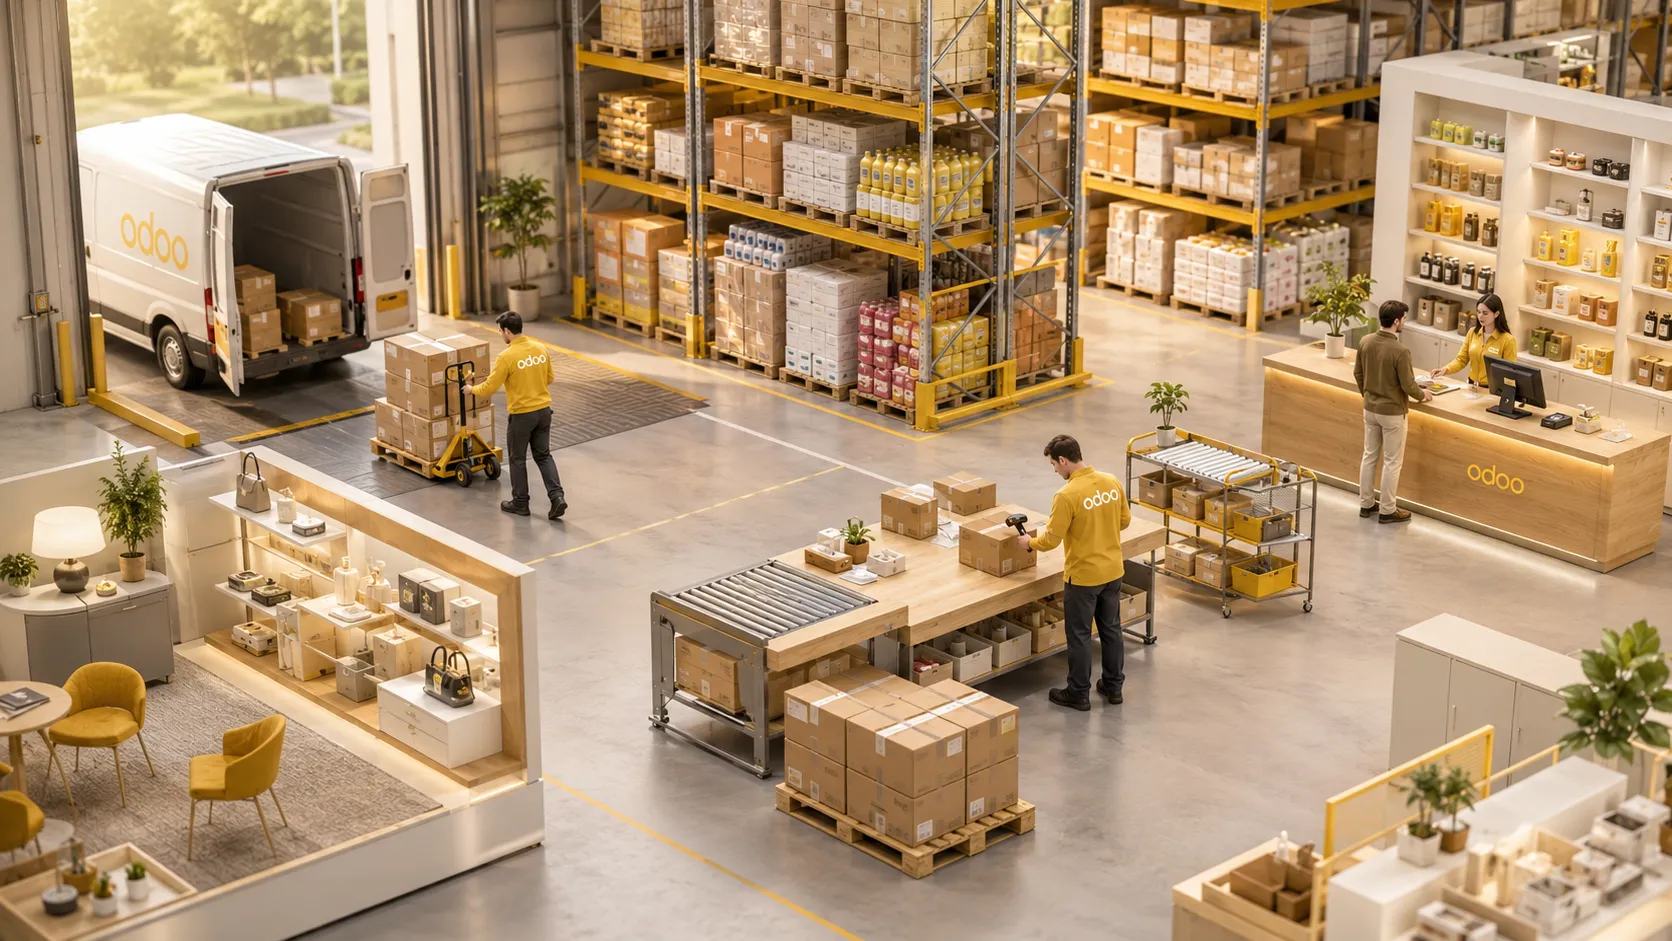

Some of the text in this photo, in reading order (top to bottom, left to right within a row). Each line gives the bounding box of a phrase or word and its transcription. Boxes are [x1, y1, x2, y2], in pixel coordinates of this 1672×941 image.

[121, 212, 189, 271] odoo
[517, 354, 547, 369] odoo
[1467, 464, 1525, 495] odoo
[1083, 489, 1119, 510] odoo
